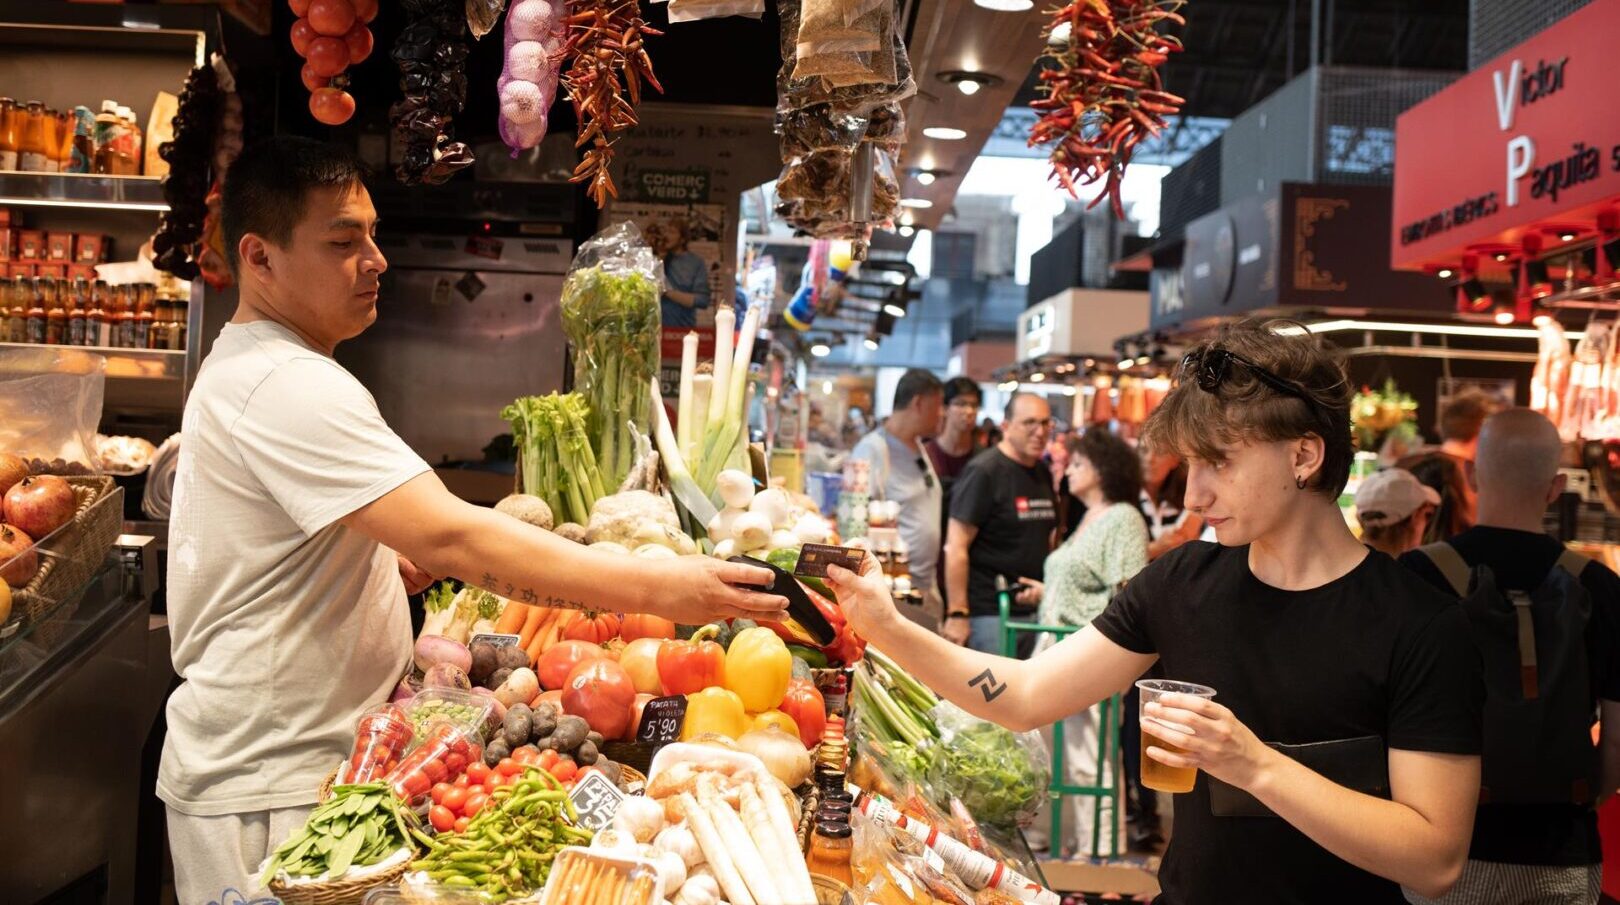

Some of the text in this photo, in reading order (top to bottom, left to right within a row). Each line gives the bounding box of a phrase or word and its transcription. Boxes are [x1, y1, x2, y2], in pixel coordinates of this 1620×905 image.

[1493, 58, 1569, 131] Victor
[647, 186, 687, 199] VERD
[1506, 135, 1600, 207] Paquita
